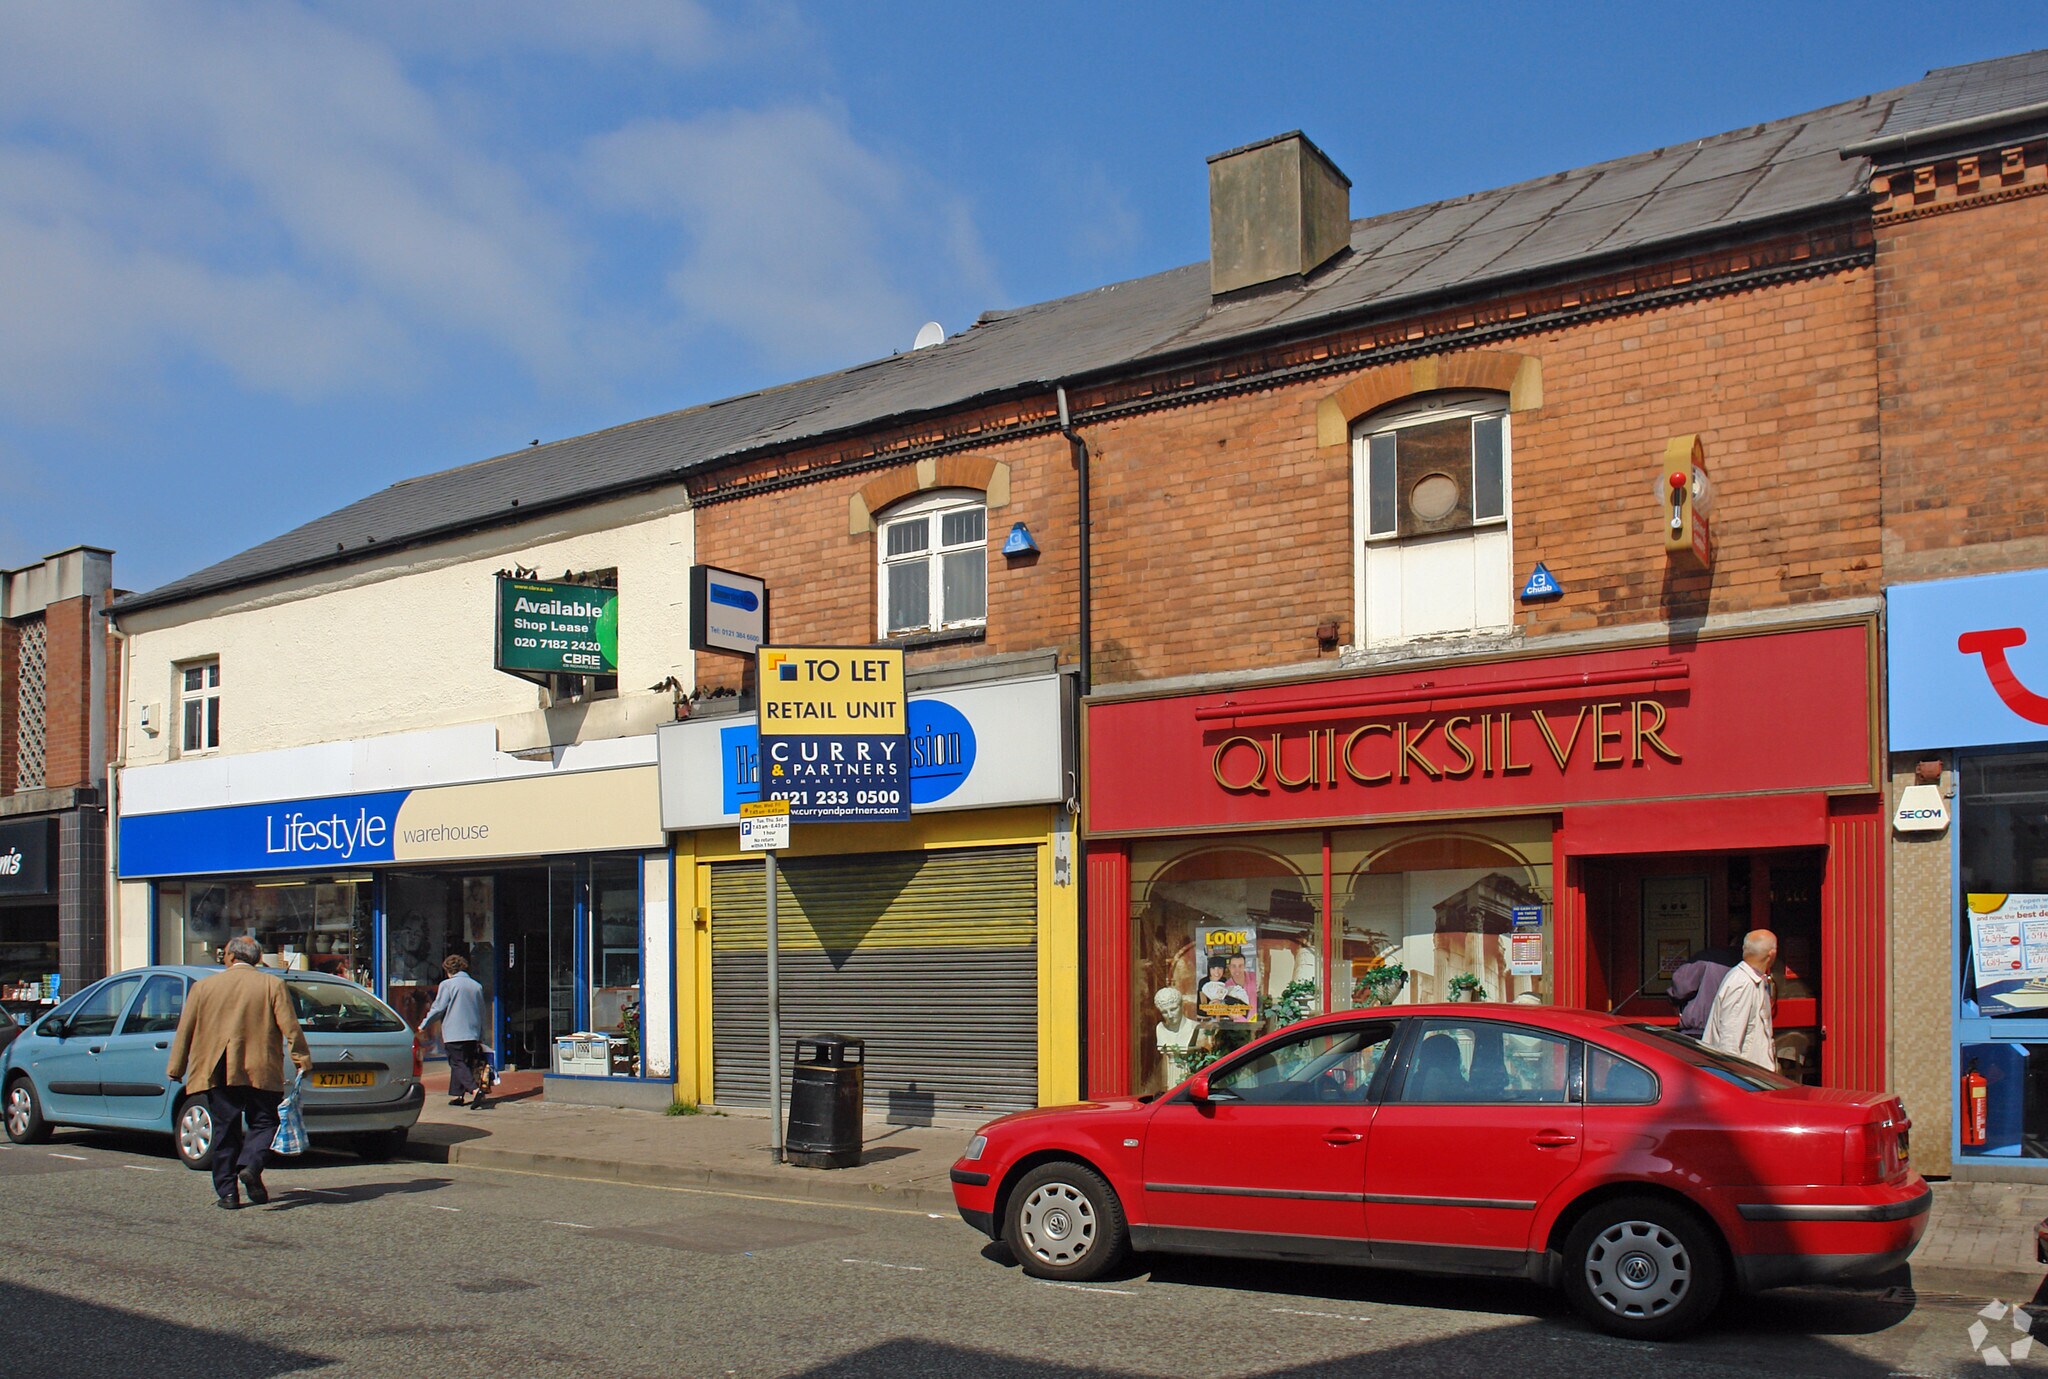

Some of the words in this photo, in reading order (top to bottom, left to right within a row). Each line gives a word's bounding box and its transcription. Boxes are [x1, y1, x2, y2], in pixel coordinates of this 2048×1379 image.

[1526, 585, 1553, 594] Chubb
[514, 597, 603, 618] Available
[514, 618, 547, 632] Shop
[551, 621, 588, 632] Lease
[722, 629, 734, 637] 0121
[514, 638, 537, 648] 020
[540, 639, 568, 649] 7182
[571, 641, 601, 651] 2420
[562, 653, 601, 665] CBRE
[805, 660, 840, 681] TO
[851, 660, 890, 681] LET
[767, 702, 837, 718] RETAIL
[846, 702, 897, 718] UNIT
[771, 742, 896, 761] CURRY
[1211, 700, 1682, 791] QUICKSILVER
[771, 764, 784, 776] &
[793, 763, 897, 776] PARTNERS
[770, 791, 808, 805] 0121
[815, 791, 848, 805] 233
[856, 790, 900, 804] 0500
[1900, 809, 1942, 819] SECOM
[266, 808, 386, 859] Lifestyle
[403, 824, 489, 843] warehouse
[743, 823, 751, 834] P
[2016, 911, 2037, 919] best
[1205, 931, 1248, 946] LOOK
[320, 1073, 345, 1085] X717
